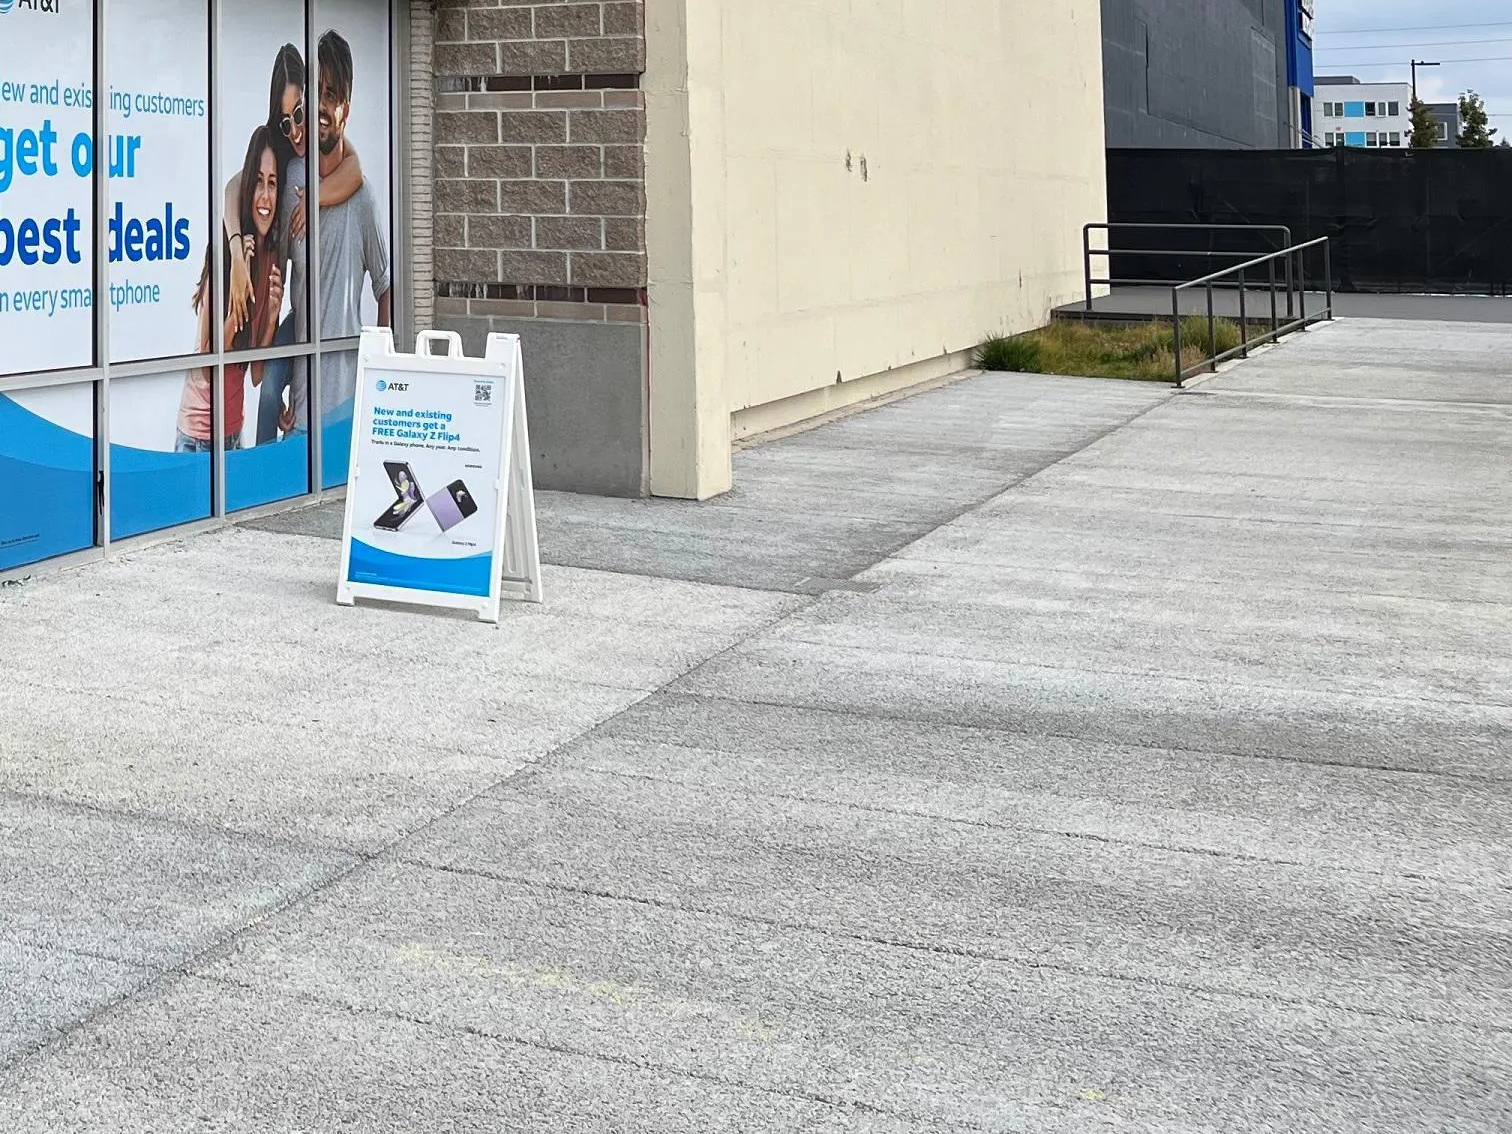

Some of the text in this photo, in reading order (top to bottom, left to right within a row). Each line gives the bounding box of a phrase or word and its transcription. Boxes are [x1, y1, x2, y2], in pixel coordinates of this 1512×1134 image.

[30, 79, 59, 106] and
[64, 82, 131, 118] exising
[134, 91, 205, 117] customers
[71, 131, 141, 178] our
[108, 202, 190, 262] deals
[13, 289, 57, 317] every
[60, 279, 161, 312] smatphone
[388, 382, 409, 391] AT&T
[372, 418, 421, 428] customers
[423, 421, 439, 431] get
[374, 406, 452, 422] New and existing
[372, 427, 460, 443] FREE Galaxy Z Flip4
